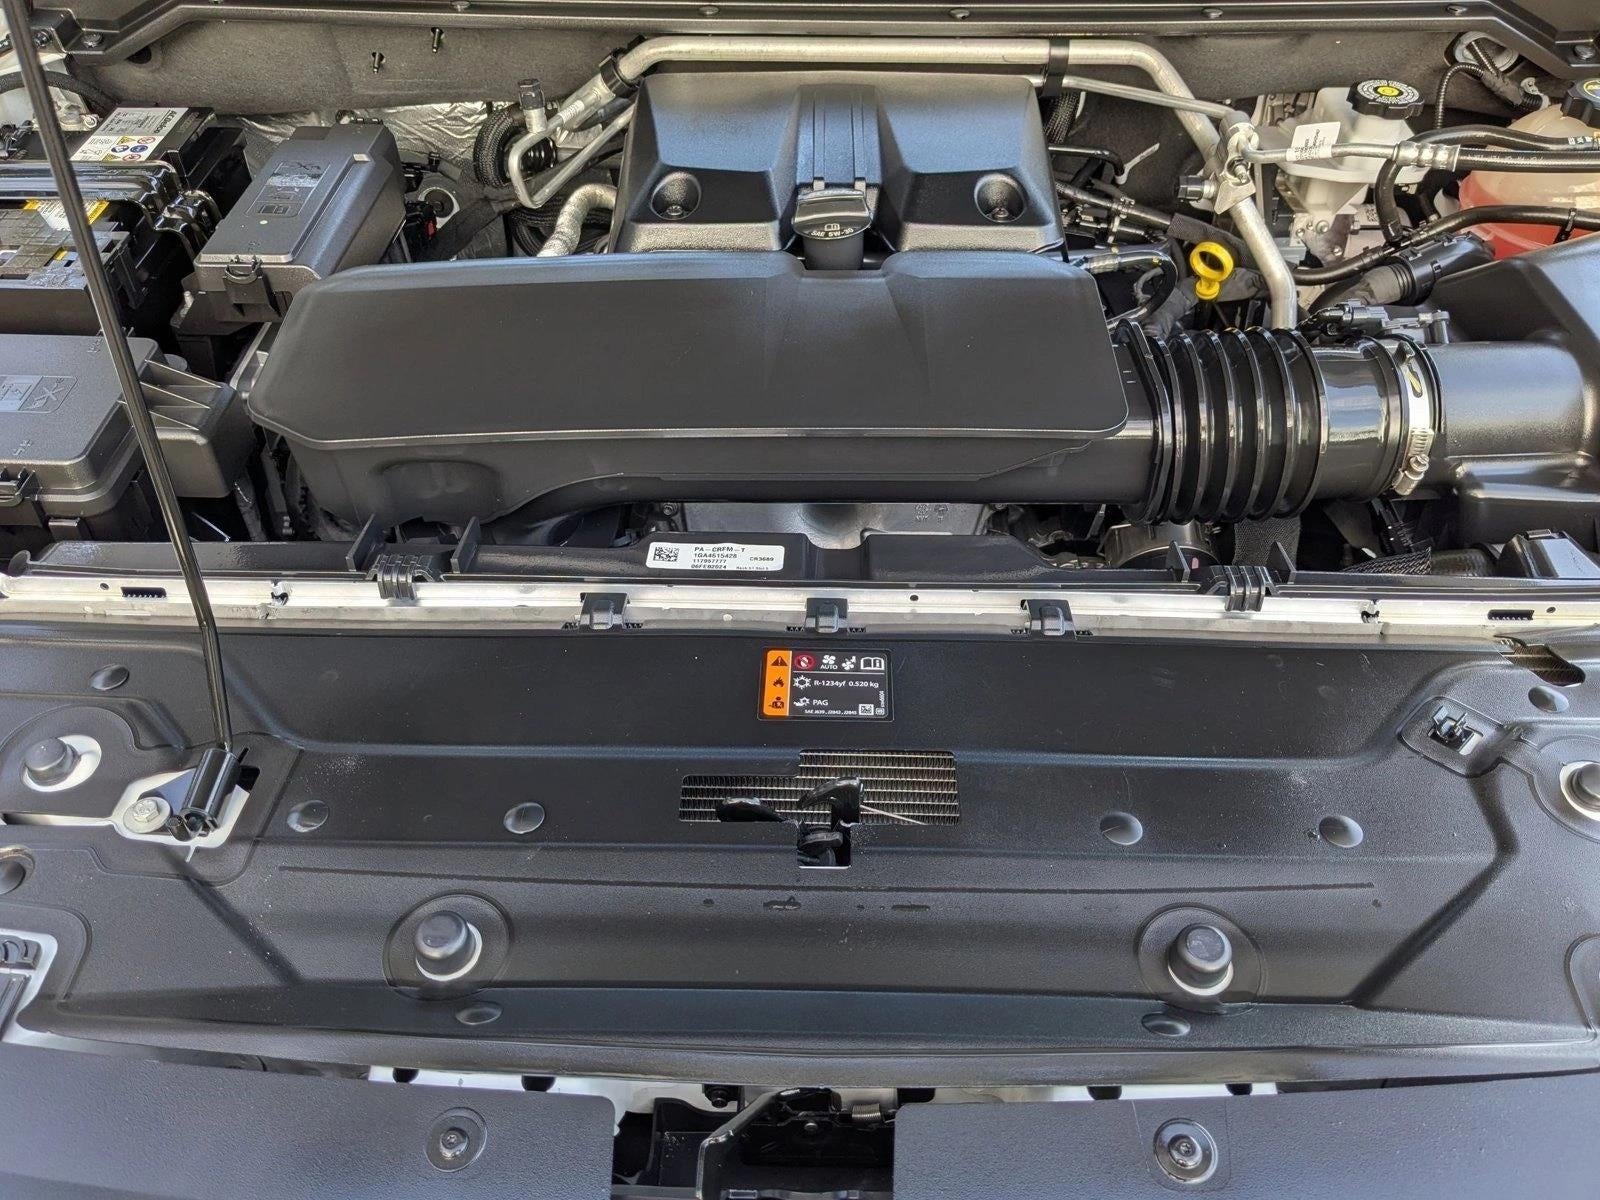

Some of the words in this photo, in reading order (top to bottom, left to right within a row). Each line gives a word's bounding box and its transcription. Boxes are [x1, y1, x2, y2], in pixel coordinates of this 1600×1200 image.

[153, 109, 178, 134] ACDelco
[828, 227, 854, 237] 5W-30
[813, 680, 846, 688] R-1234yf
[869, 681, 879, 689] kg
